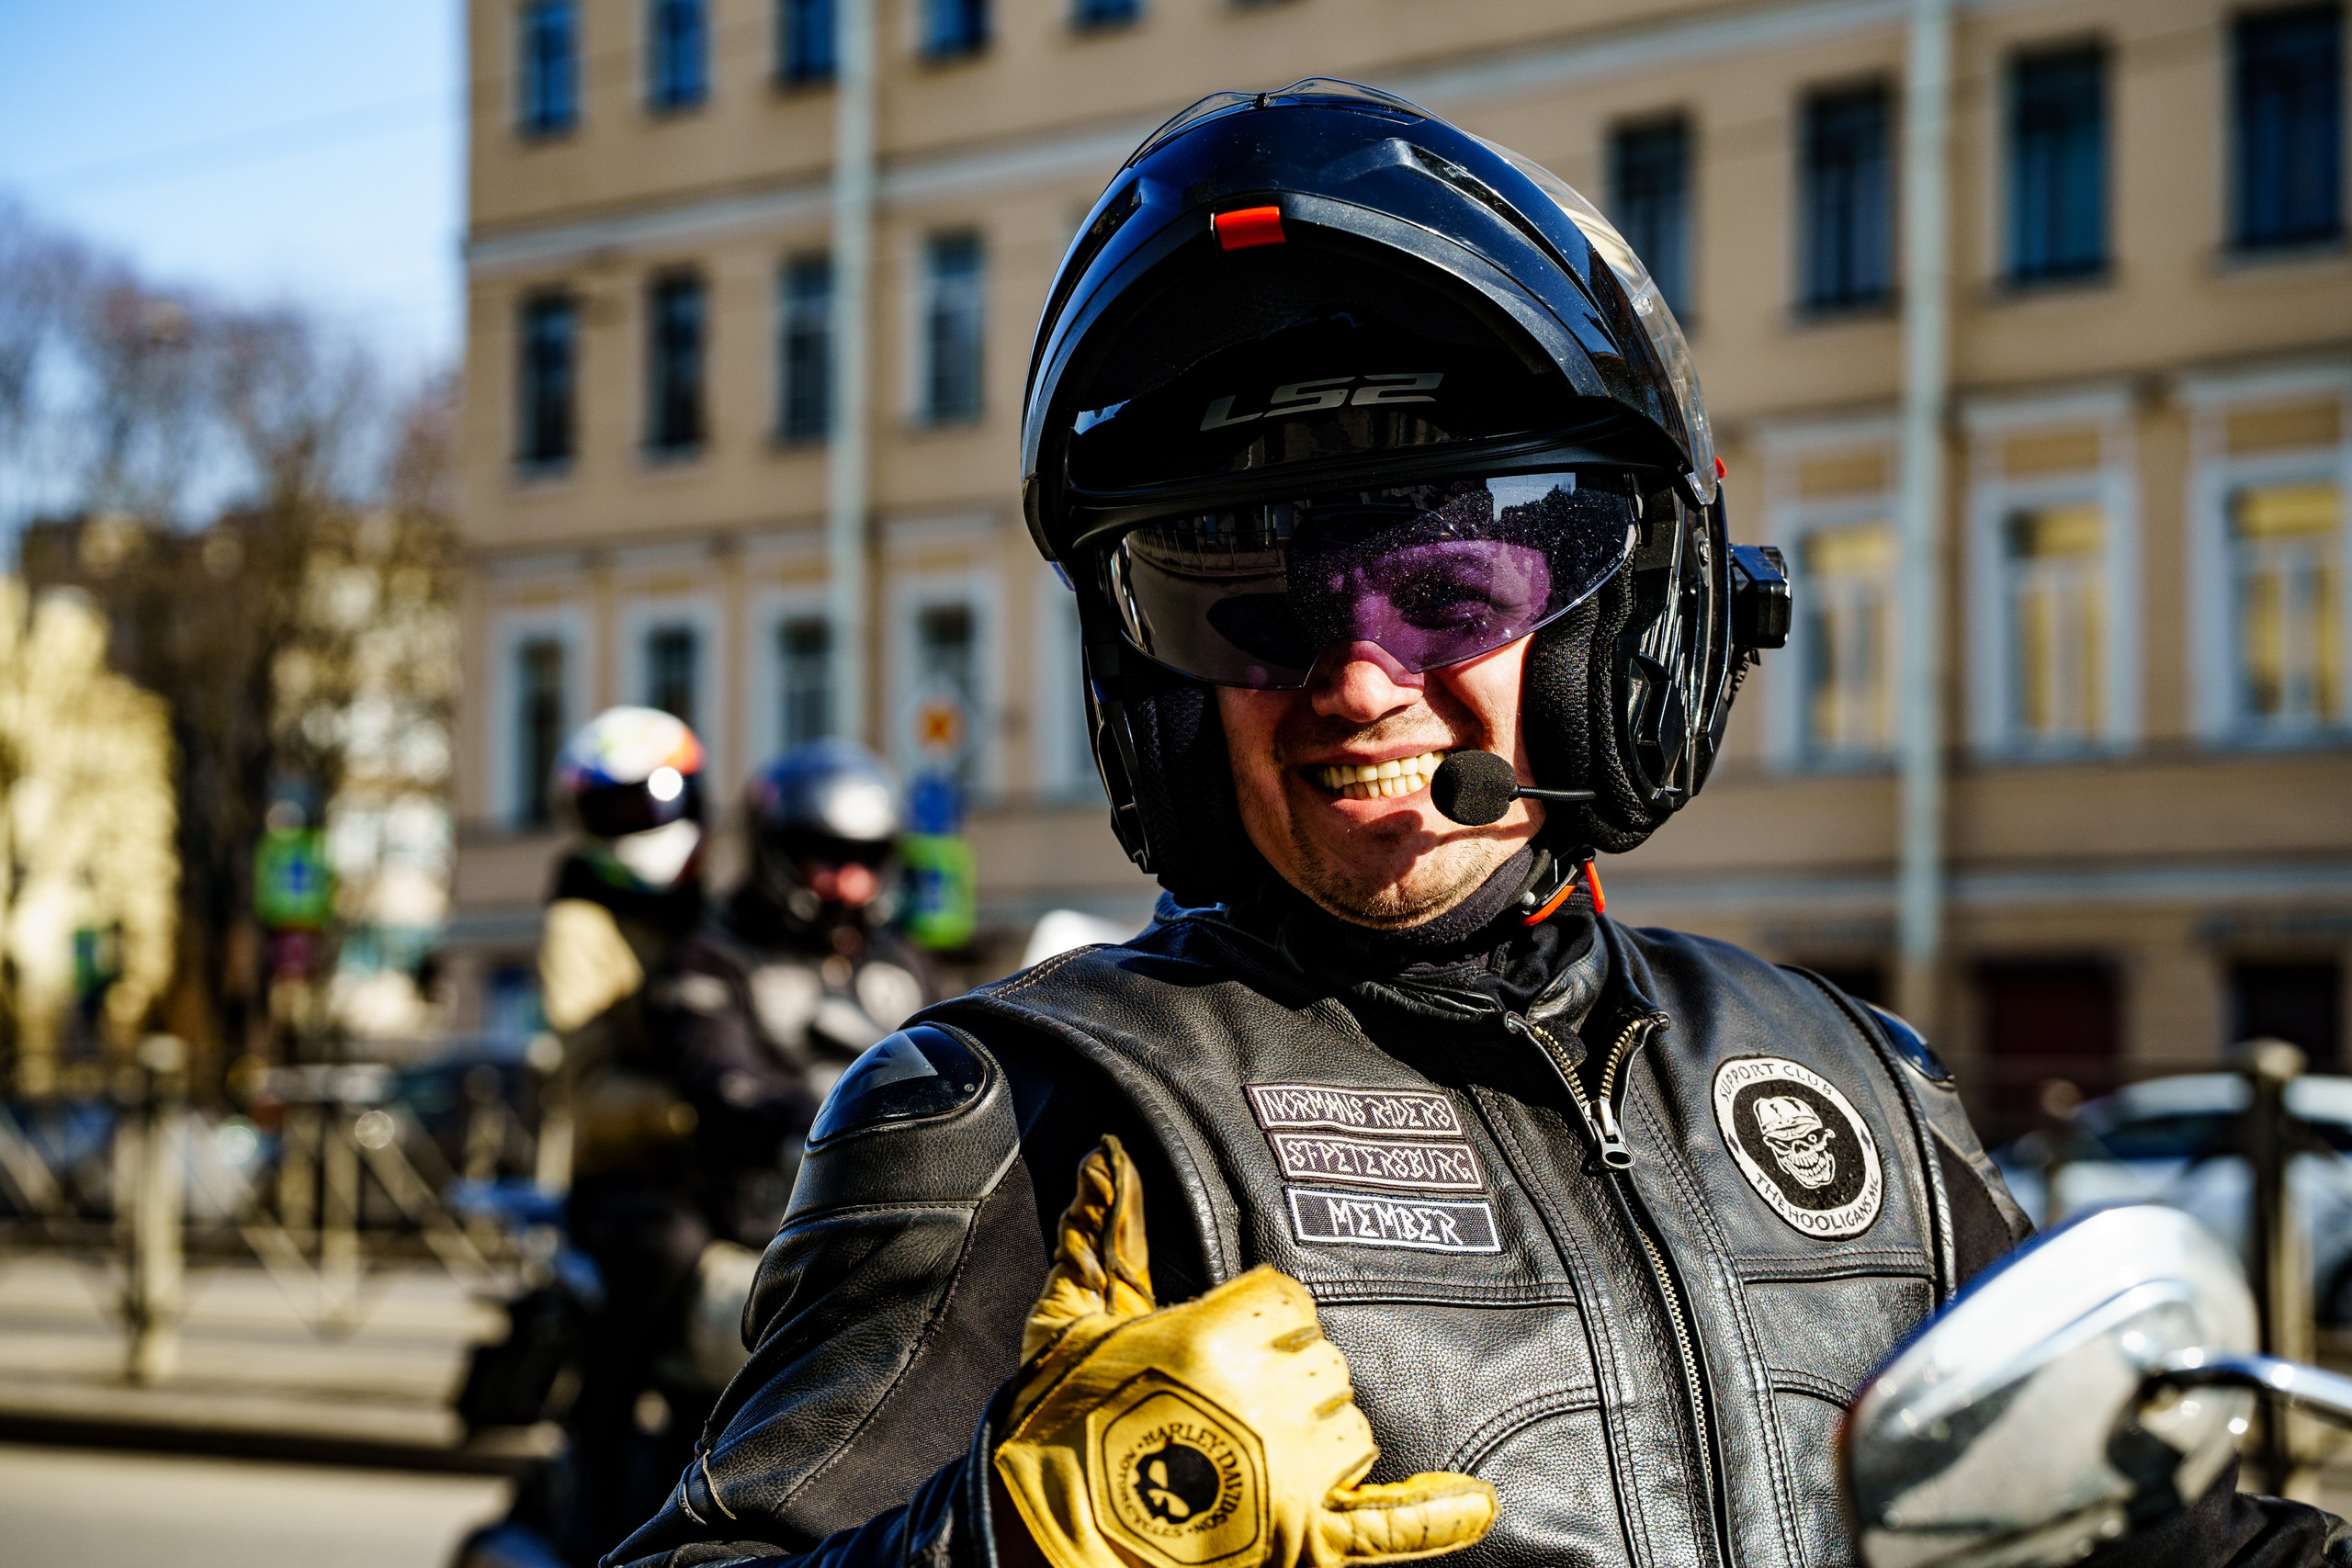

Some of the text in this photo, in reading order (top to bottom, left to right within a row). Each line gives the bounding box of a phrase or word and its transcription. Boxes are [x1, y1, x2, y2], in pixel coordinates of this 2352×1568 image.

[1200, 372, 1444, 432] LS2
[1720, 1063, 1833, 1102] SUPPORT CLUB
[1262, 1091, 1451, 1128] NORMANS RIDERS
[1327, 1197, 1464, 1246] MEMBER
[1756, 1172, 1879, 1232] THE HOOLIGANS MC
